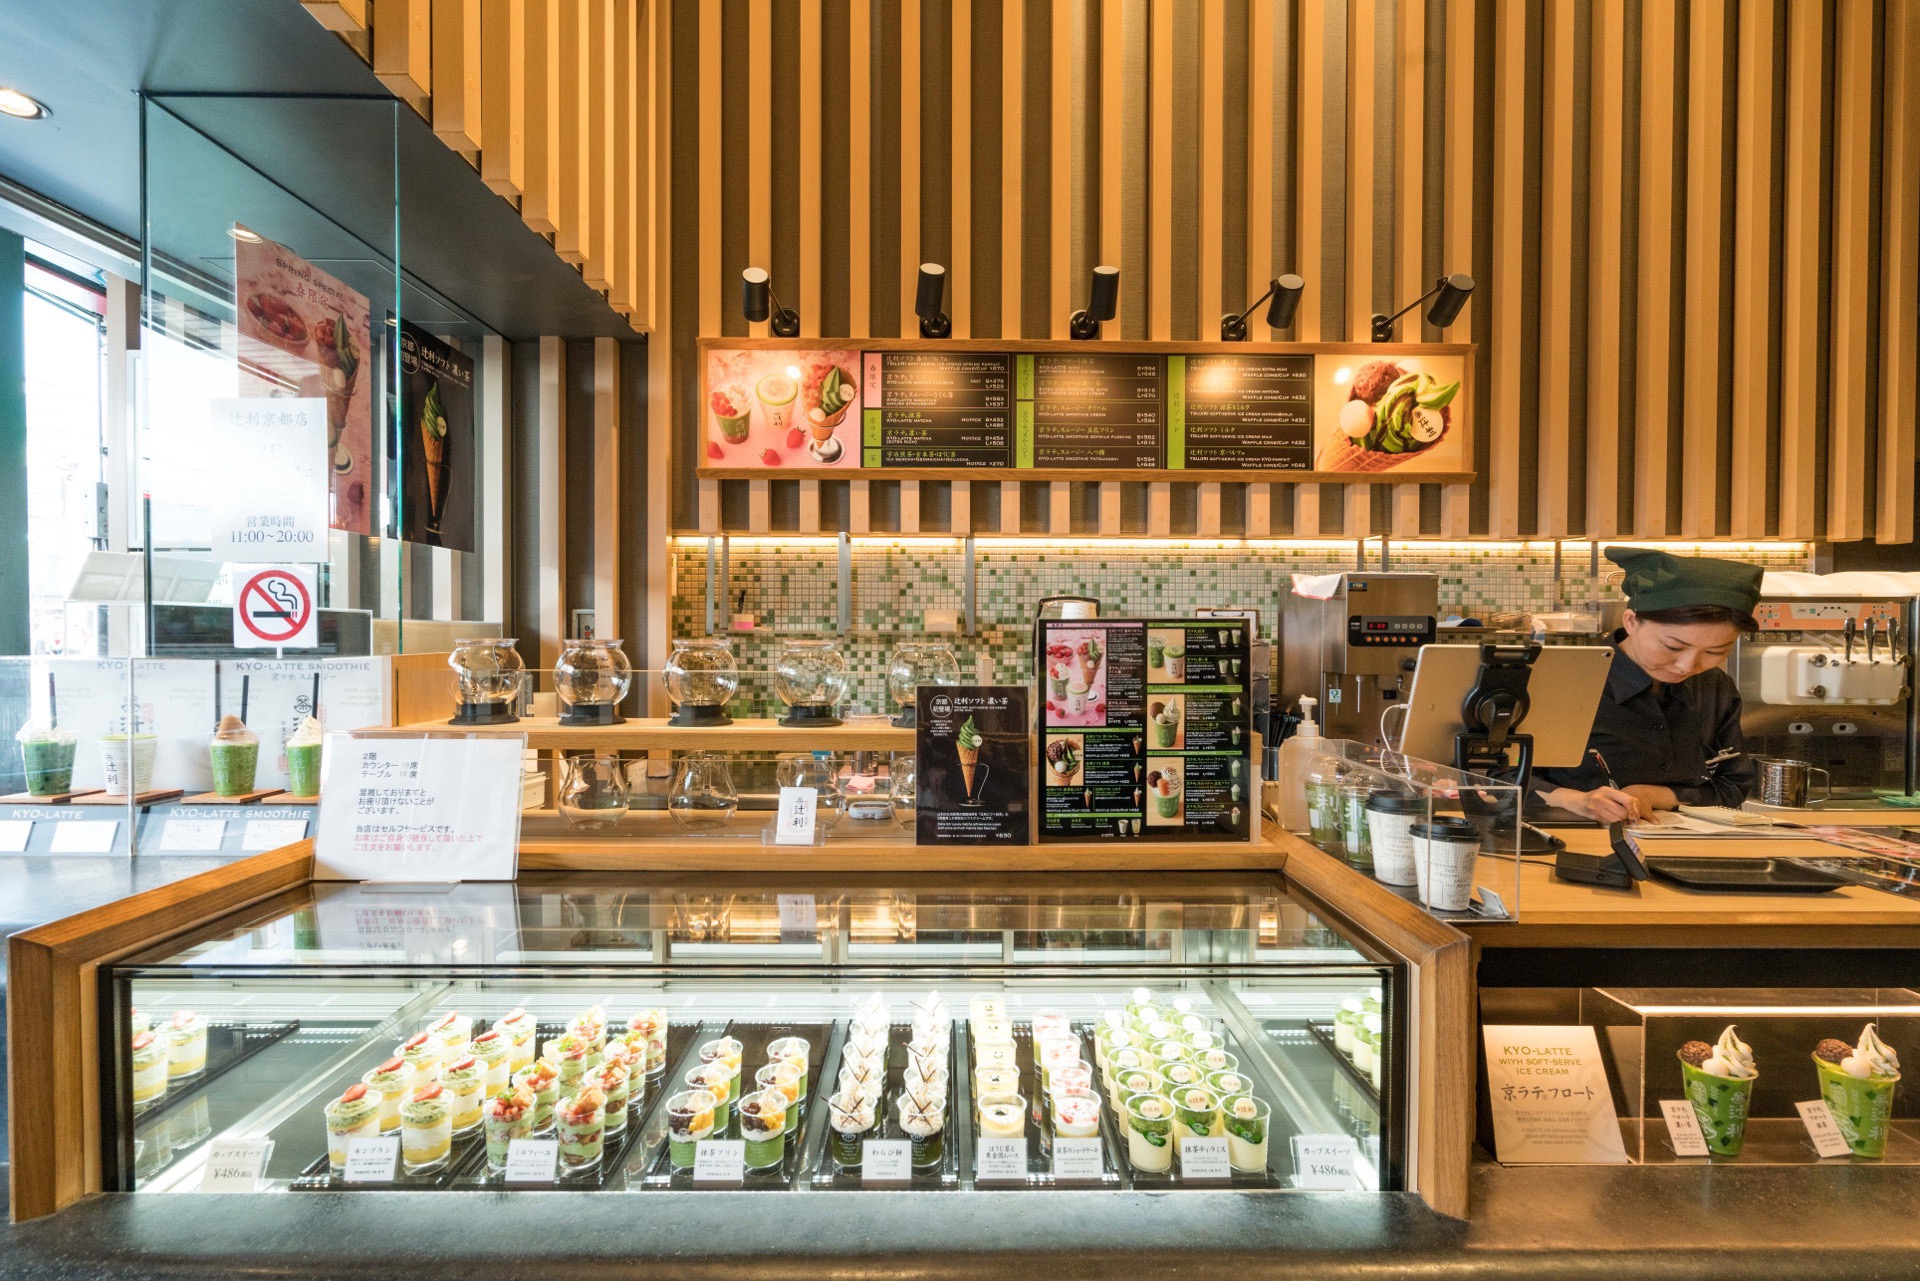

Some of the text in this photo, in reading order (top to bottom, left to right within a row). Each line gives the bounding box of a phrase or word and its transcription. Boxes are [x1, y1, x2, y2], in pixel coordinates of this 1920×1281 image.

[276, 258, 345, 302] SPRING SPECIAL
[296, 282, 330, 311] 春限定
[869, 454, 878, 464] 茶
[247, 516, 295, 528] 営業時間
[12, 810, 83, 819] KYO-LATTE
[170, 809, 310, 819] KYO-LATTE SMOOTHIE
[792, 805, 805, 827] 辻利
[1503, 1046, 1573, 1056] KYO-LATTE
[1726, 1105, 1745, 1137] 辻利
[213, 1150, 261, 1158] カップスイーツ
[701, 1148, 738, 1157] 抹茶プリン
[1185, 1145, 1226, 1153] 抹茶ティラミス
[1304, 1147, 1350, 1155] カップスイーツ
[214, 1168, 253, 1179] ¥486税込
[1311, 1164, 1351, 1176] ¥486税込
